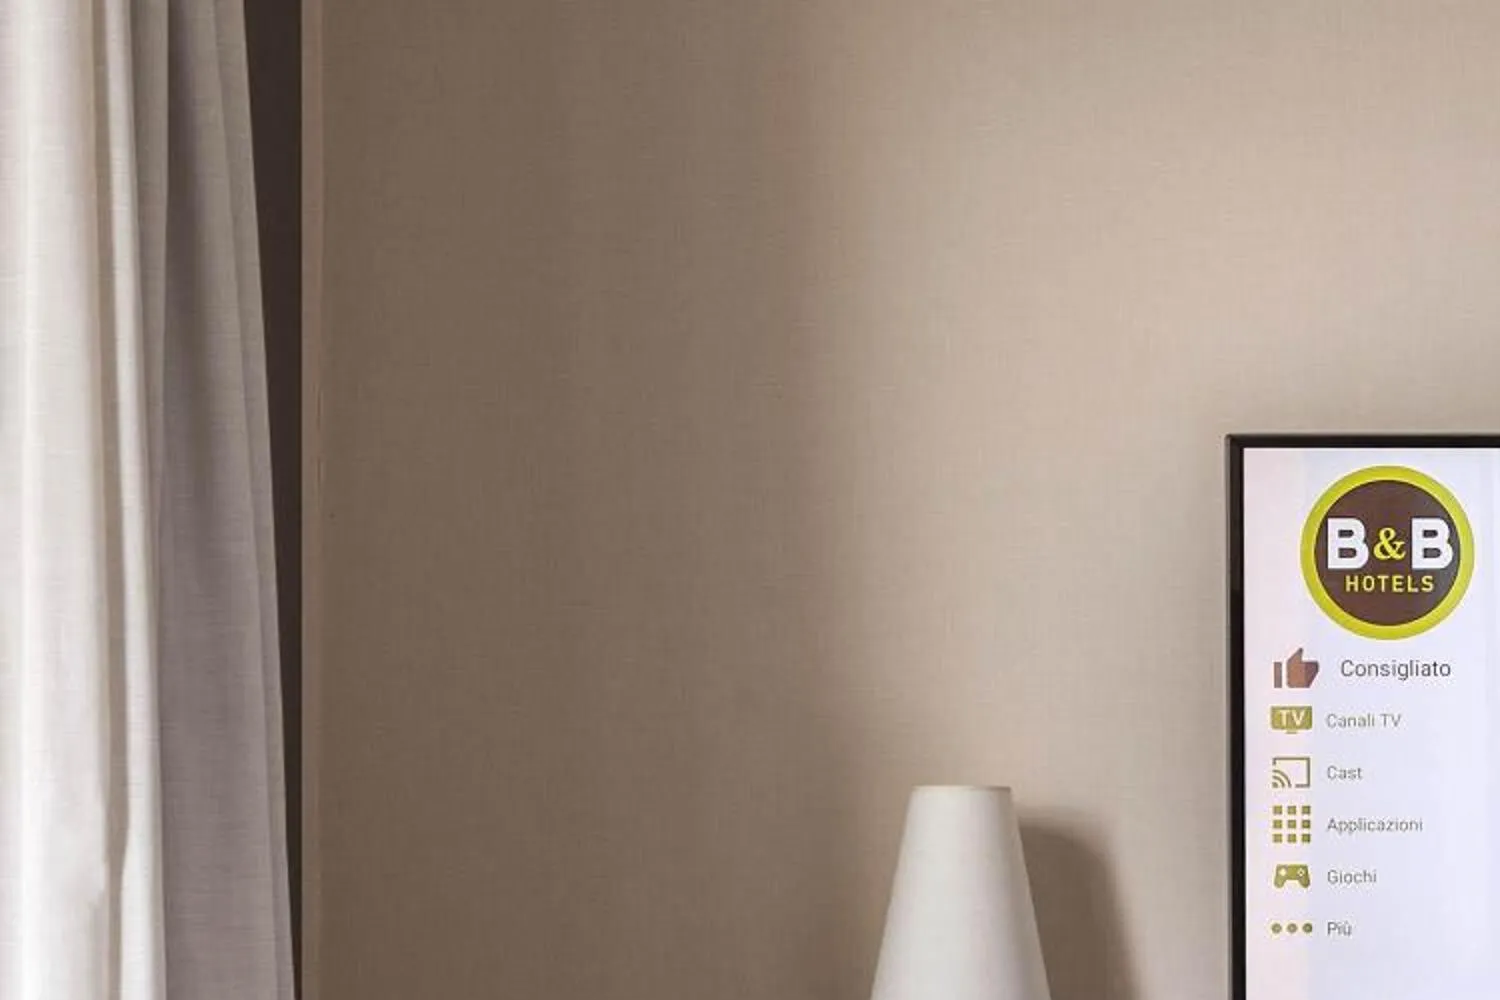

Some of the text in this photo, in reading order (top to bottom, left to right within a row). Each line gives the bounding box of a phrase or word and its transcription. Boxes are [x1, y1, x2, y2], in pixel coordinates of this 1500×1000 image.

[1326, 517, 1454, 569] B&B
[1345, 575, 1436, 593] HOTELS
[1340, 659, 1452, 681] Consigliato
[1278, 709, 1305, 727] TV
[1326, 713, 1402, 728] Canali TV
[1326, 765, 1363, 781] Cast
[1326, 817, 1424, 834] Applicazioni
[1326, 869, 1378, 885] Giochi
[1326, 920, 1353, 937] Più
